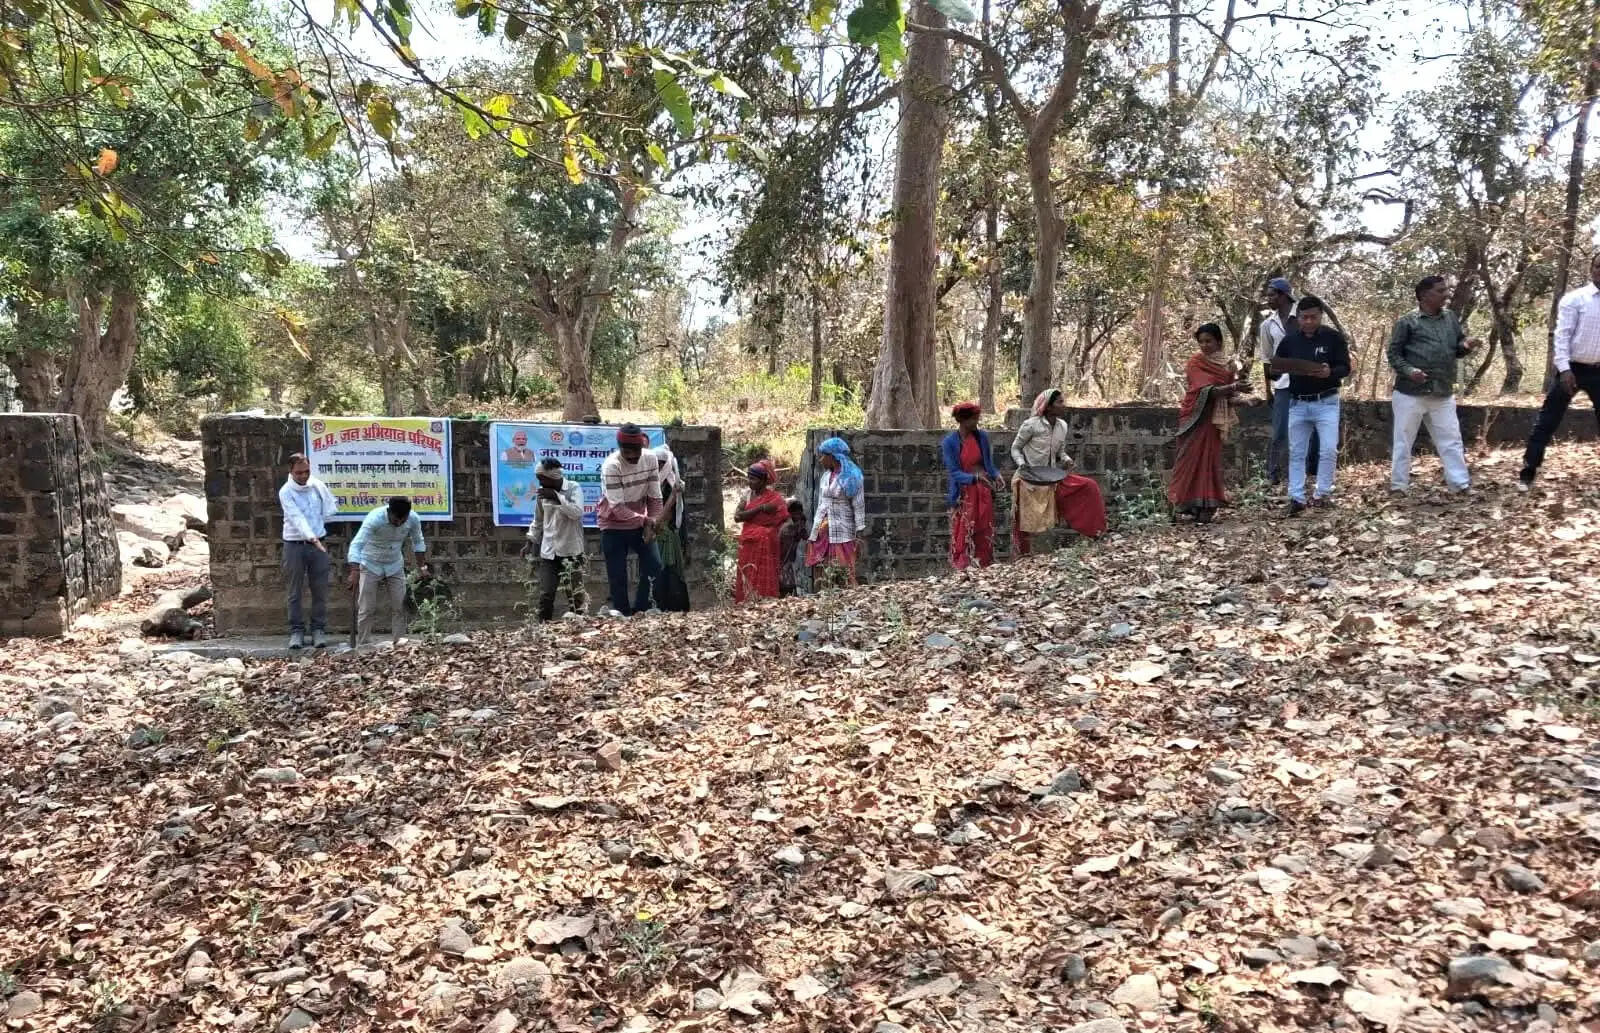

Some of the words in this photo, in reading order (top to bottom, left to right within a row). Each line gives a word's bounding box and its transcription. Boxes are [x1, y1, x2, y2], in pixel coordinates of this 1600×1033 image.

[340, 427, 360, 442] जन
[362, 422, 405, 442] अभियान
[540, 448, 559, 457] जल
[562, 446, 586, 458] गंगा
[318, 463, 333, 475] ग्राम
[335, 460, 358, 473] विकास
[388, 460, 410, 473] समिति
[352, 491, 377, 505] हार्दिक
[413, 495, 434, 505] करता
[437, 491, 443, 505] है
